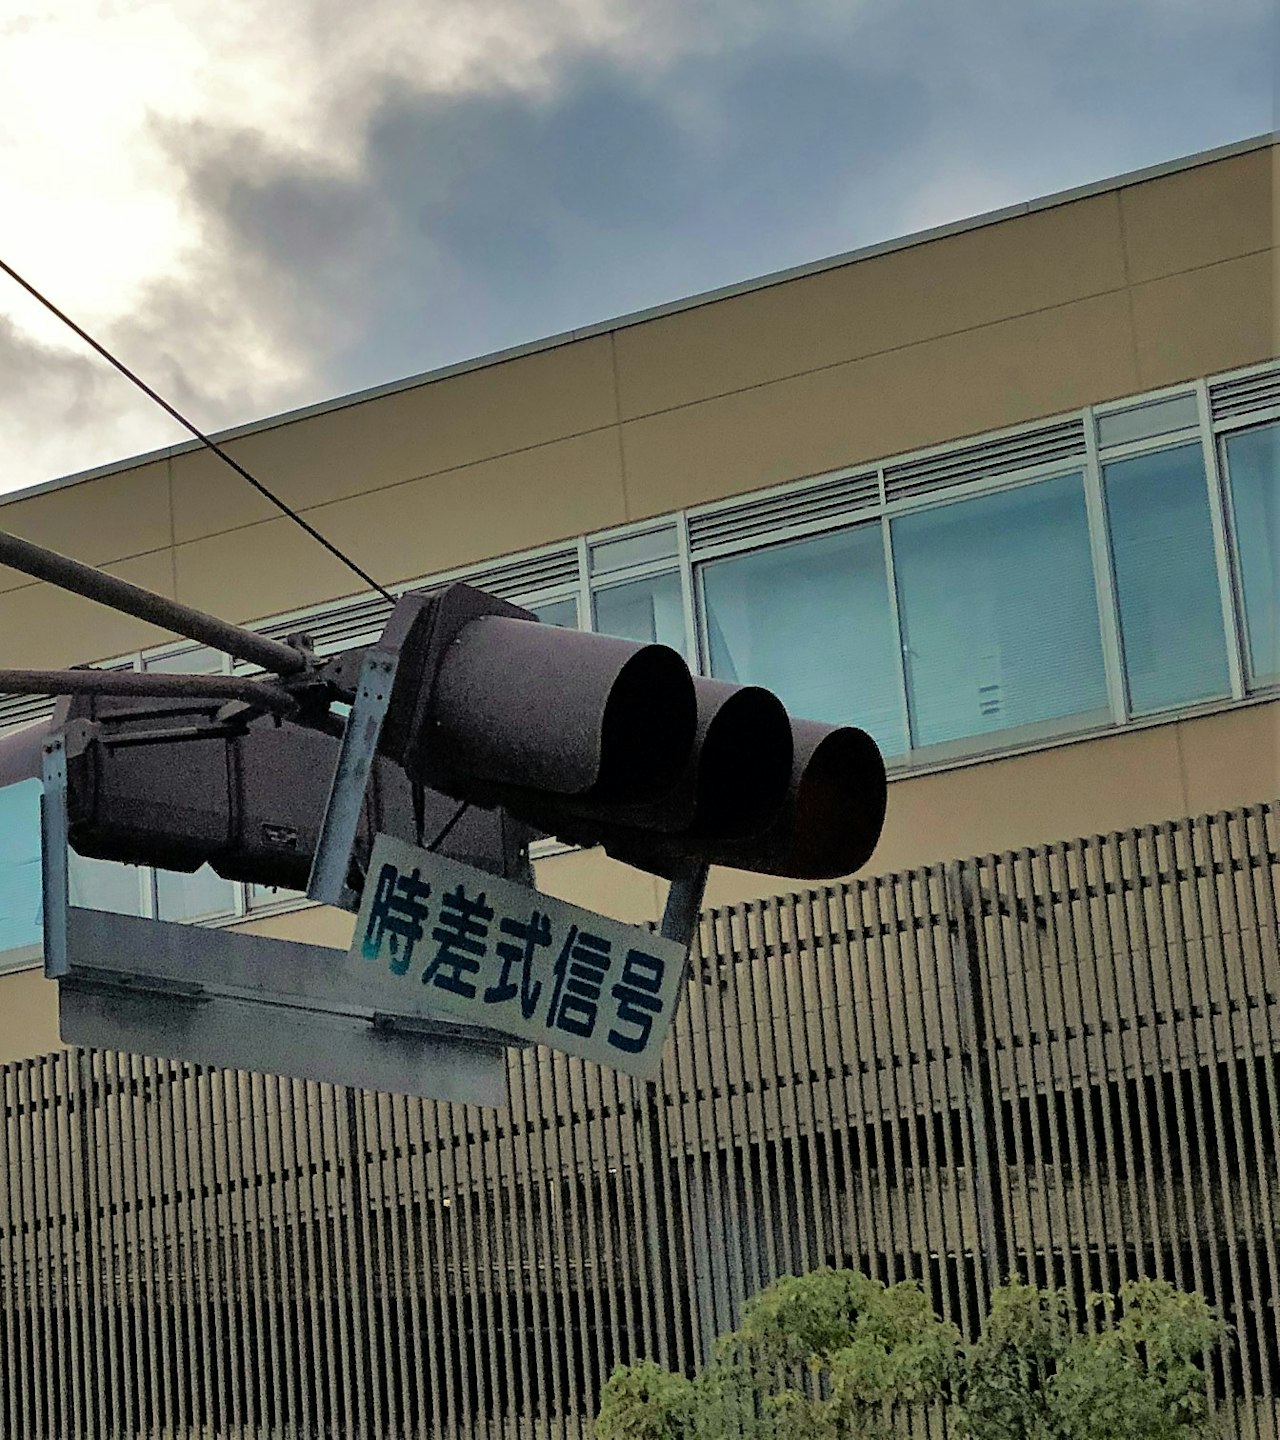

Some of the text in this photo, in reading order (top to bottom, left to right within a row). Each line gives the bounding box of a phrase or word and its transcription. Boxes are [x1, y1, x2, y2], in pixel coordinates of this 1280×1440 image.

[360, 862, 666, 1055] 時差式信号
